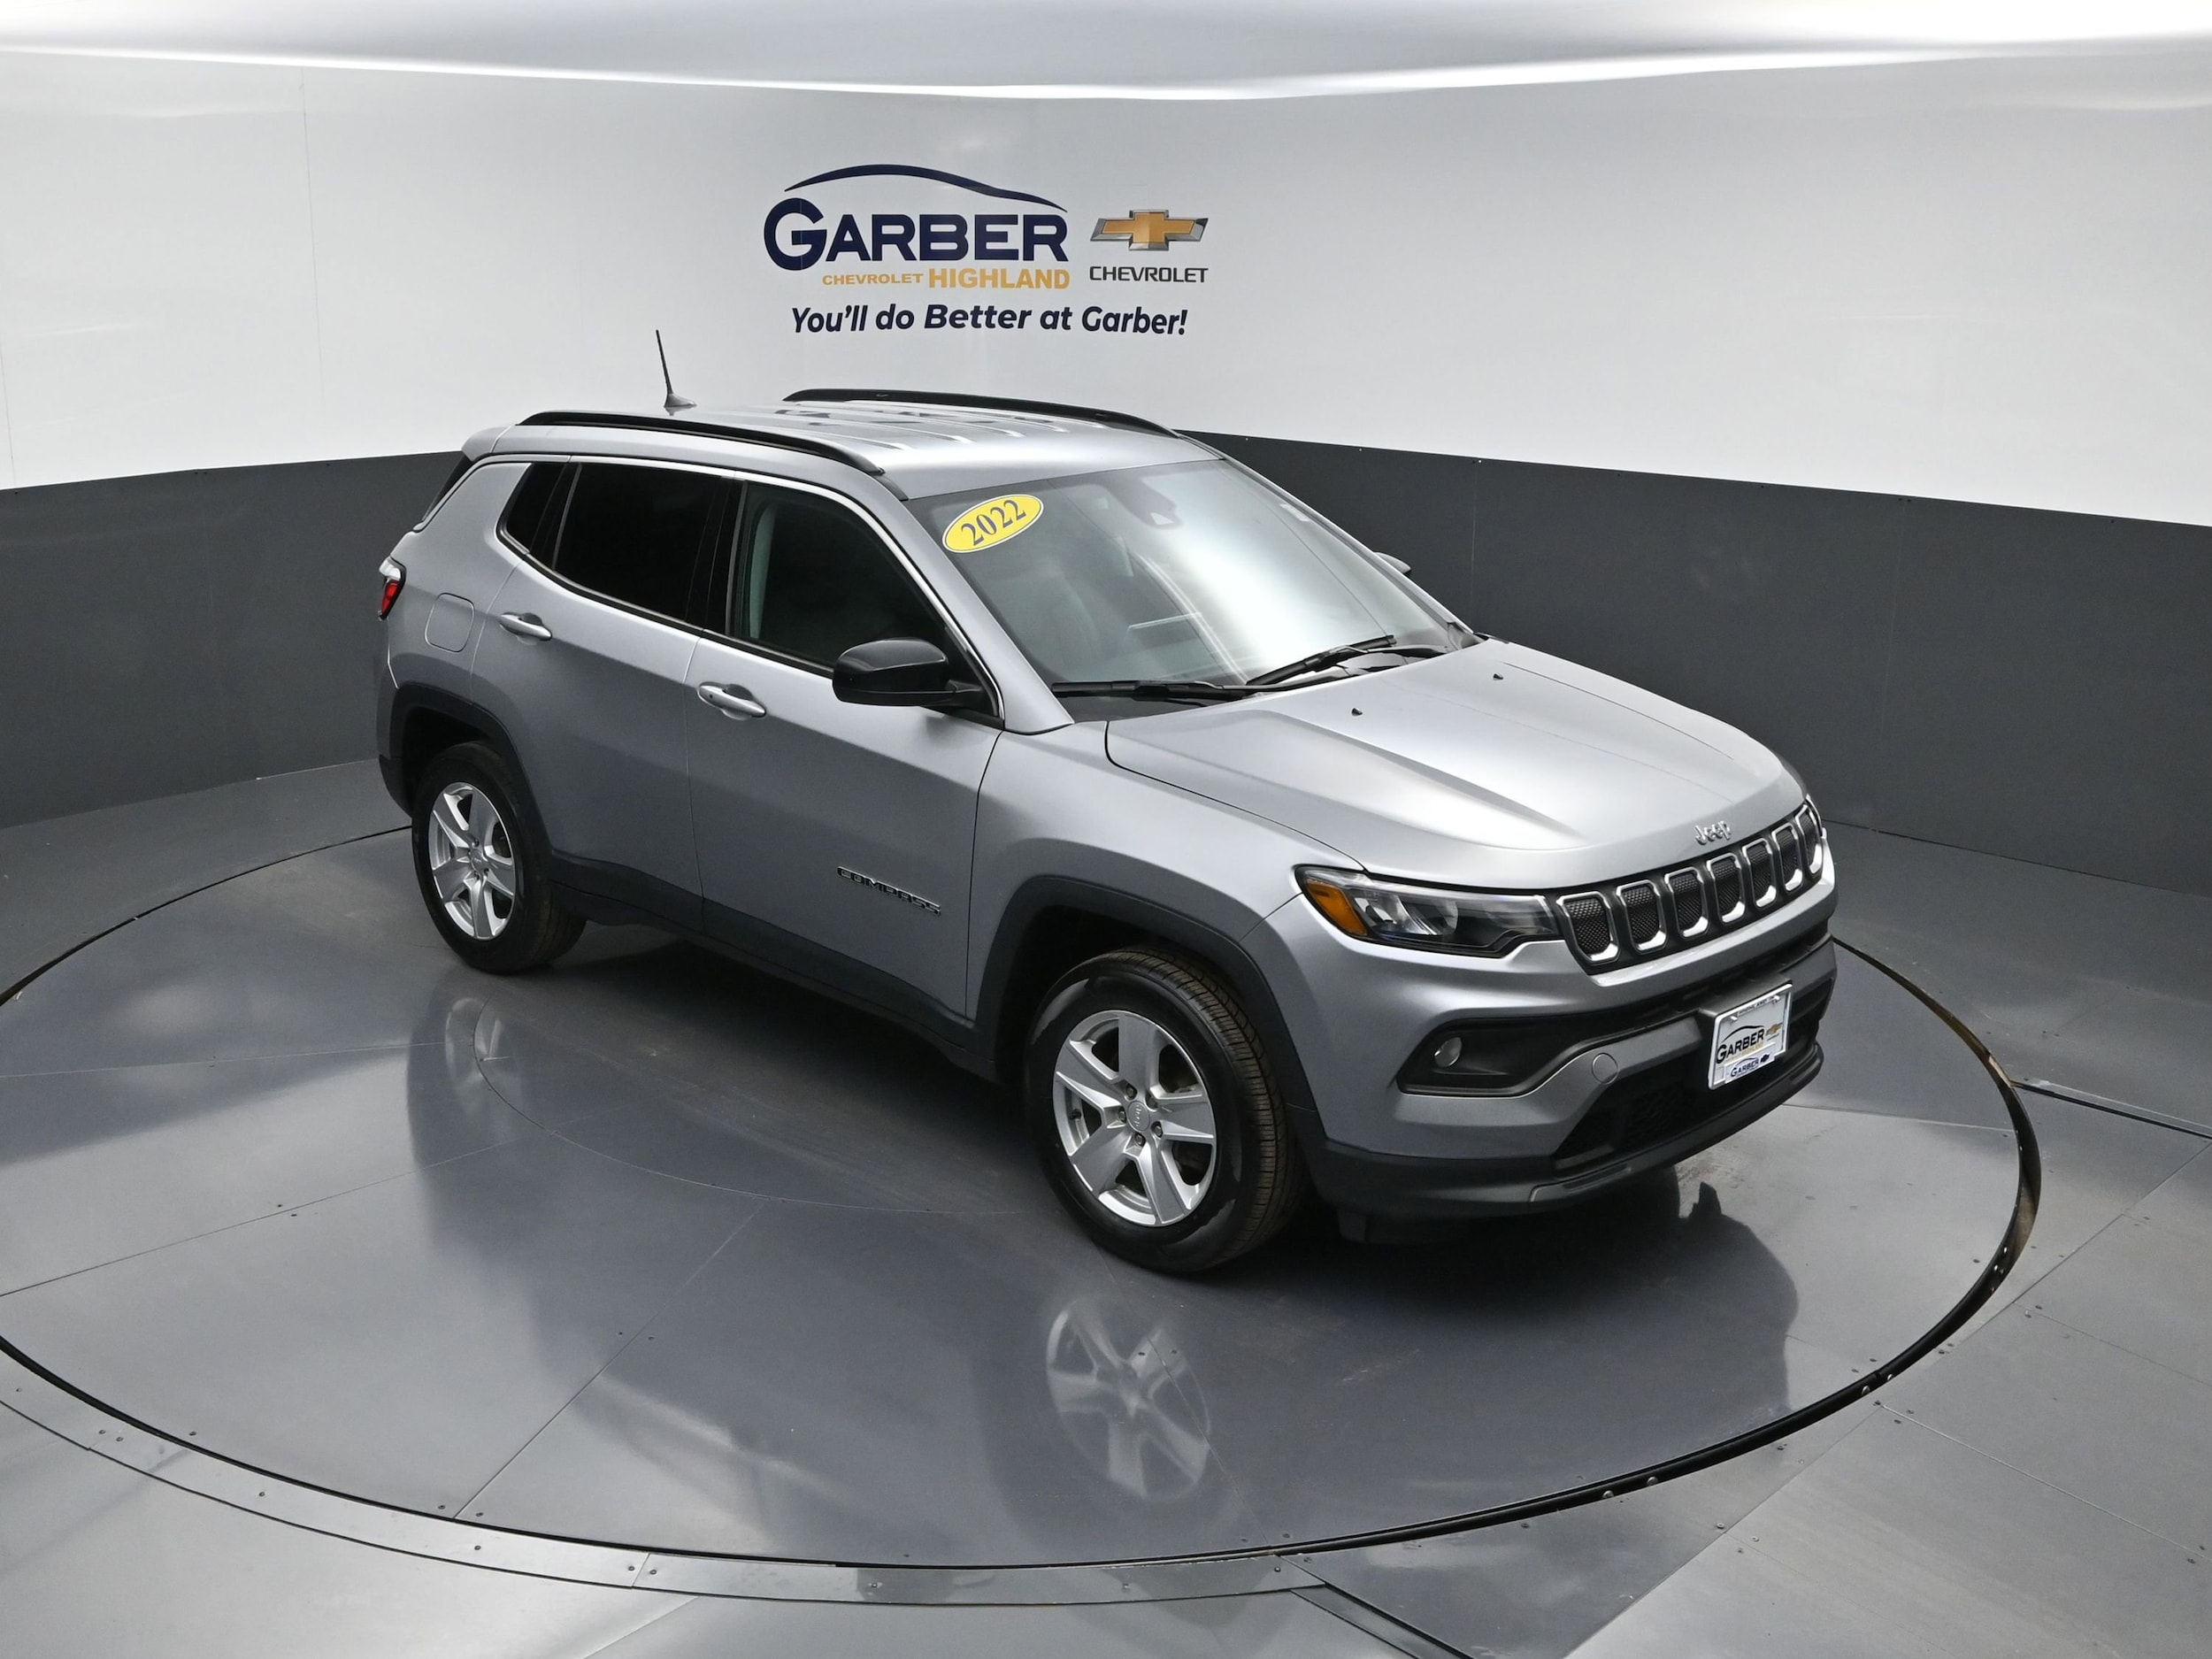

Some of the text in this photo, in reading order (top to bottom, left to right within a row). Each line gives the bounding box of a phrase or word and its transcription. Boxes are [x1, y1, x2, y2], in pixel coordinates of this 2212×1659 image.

[763, 197, 1070, 271] GARBER
[821, 267, 1071, 290] CHEVROLET HIGHLAND
[1089, 265, 1209, 283] CHEVROLET
[792, 303, 1188, 335] You'll do Better at Garber!
[961, 499, 1026, 546] 2022
[1694, 820, 1732, 845] Jeep
[1717, 1028, 1764, 1064] GARBER
[1730, 1059, 1759, 1078] GARBER
